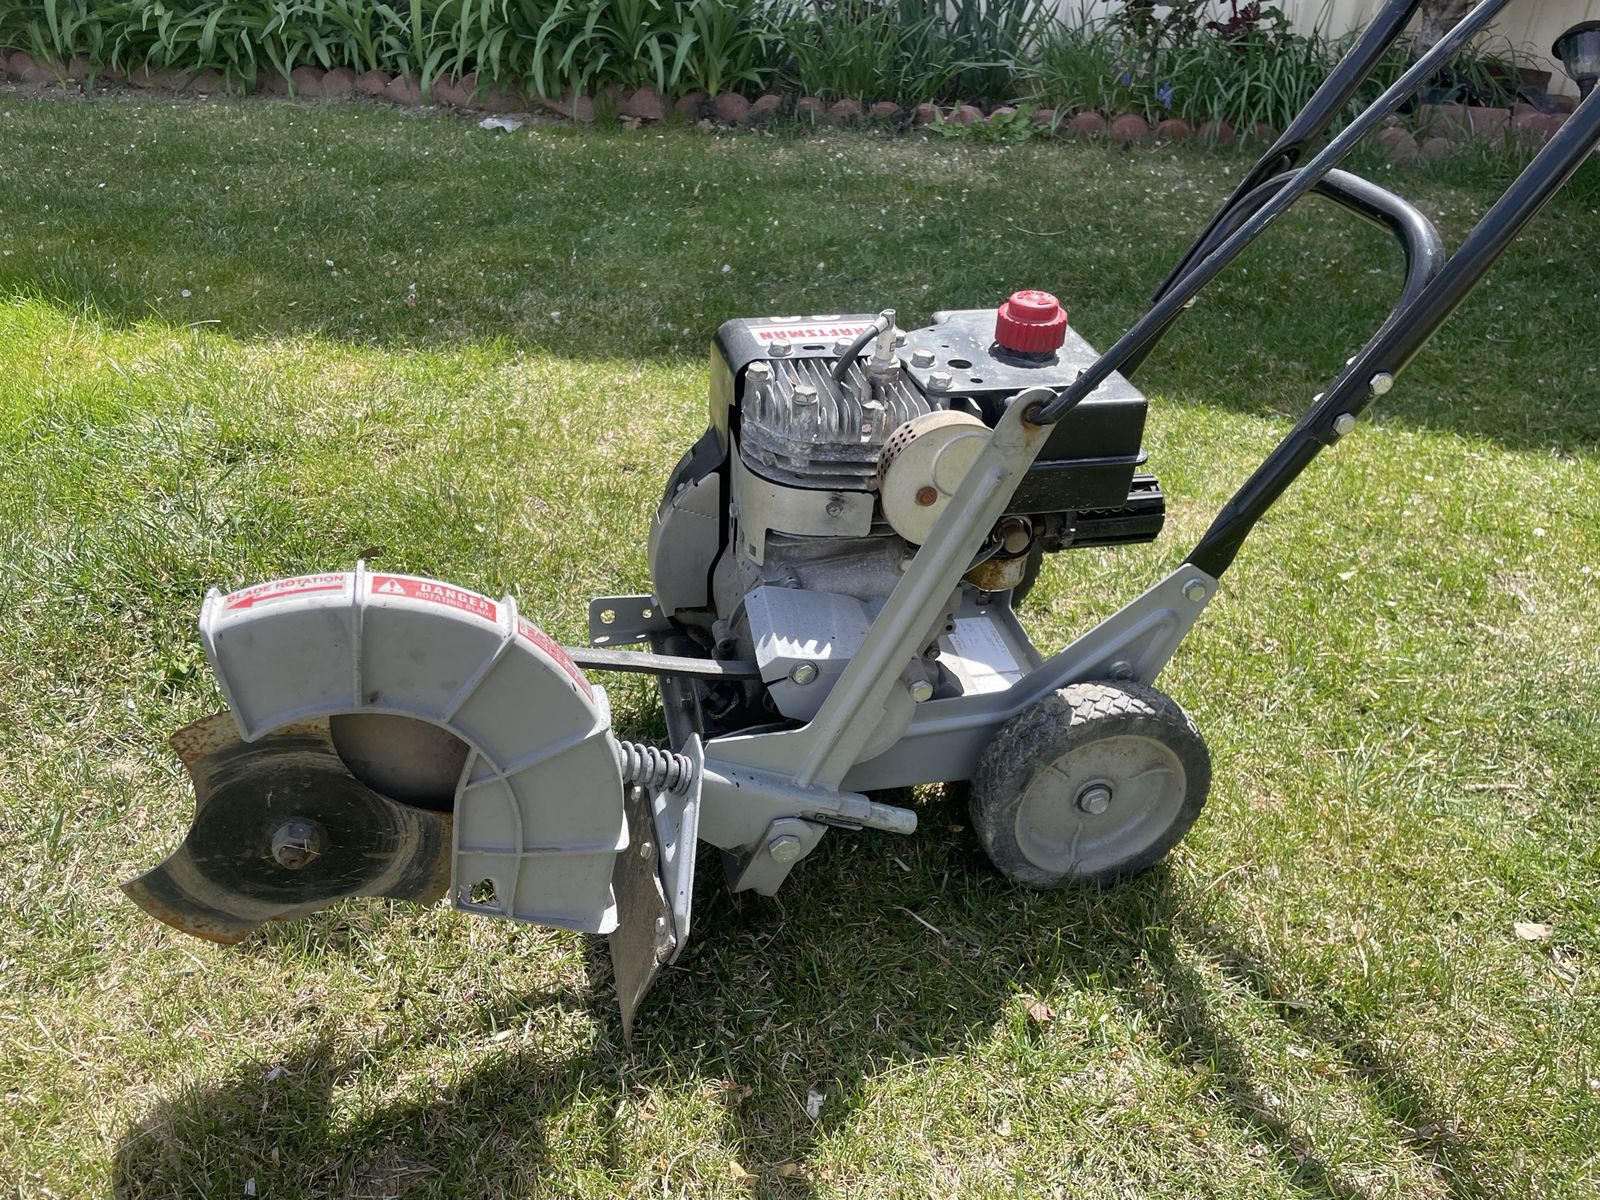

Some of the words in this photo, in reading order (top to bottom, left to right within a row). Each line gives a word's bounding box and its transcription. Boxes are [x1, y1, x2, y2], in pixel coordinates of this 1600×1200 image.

[759, 327, 865, 340] RAFTSMAN
[227, 583, 272, 603] BLADE
[275, 575, 344, 589] ROTATION
[415, 591, 462, 608] ROTATING
[420, 583, 489, 611] DANGER
